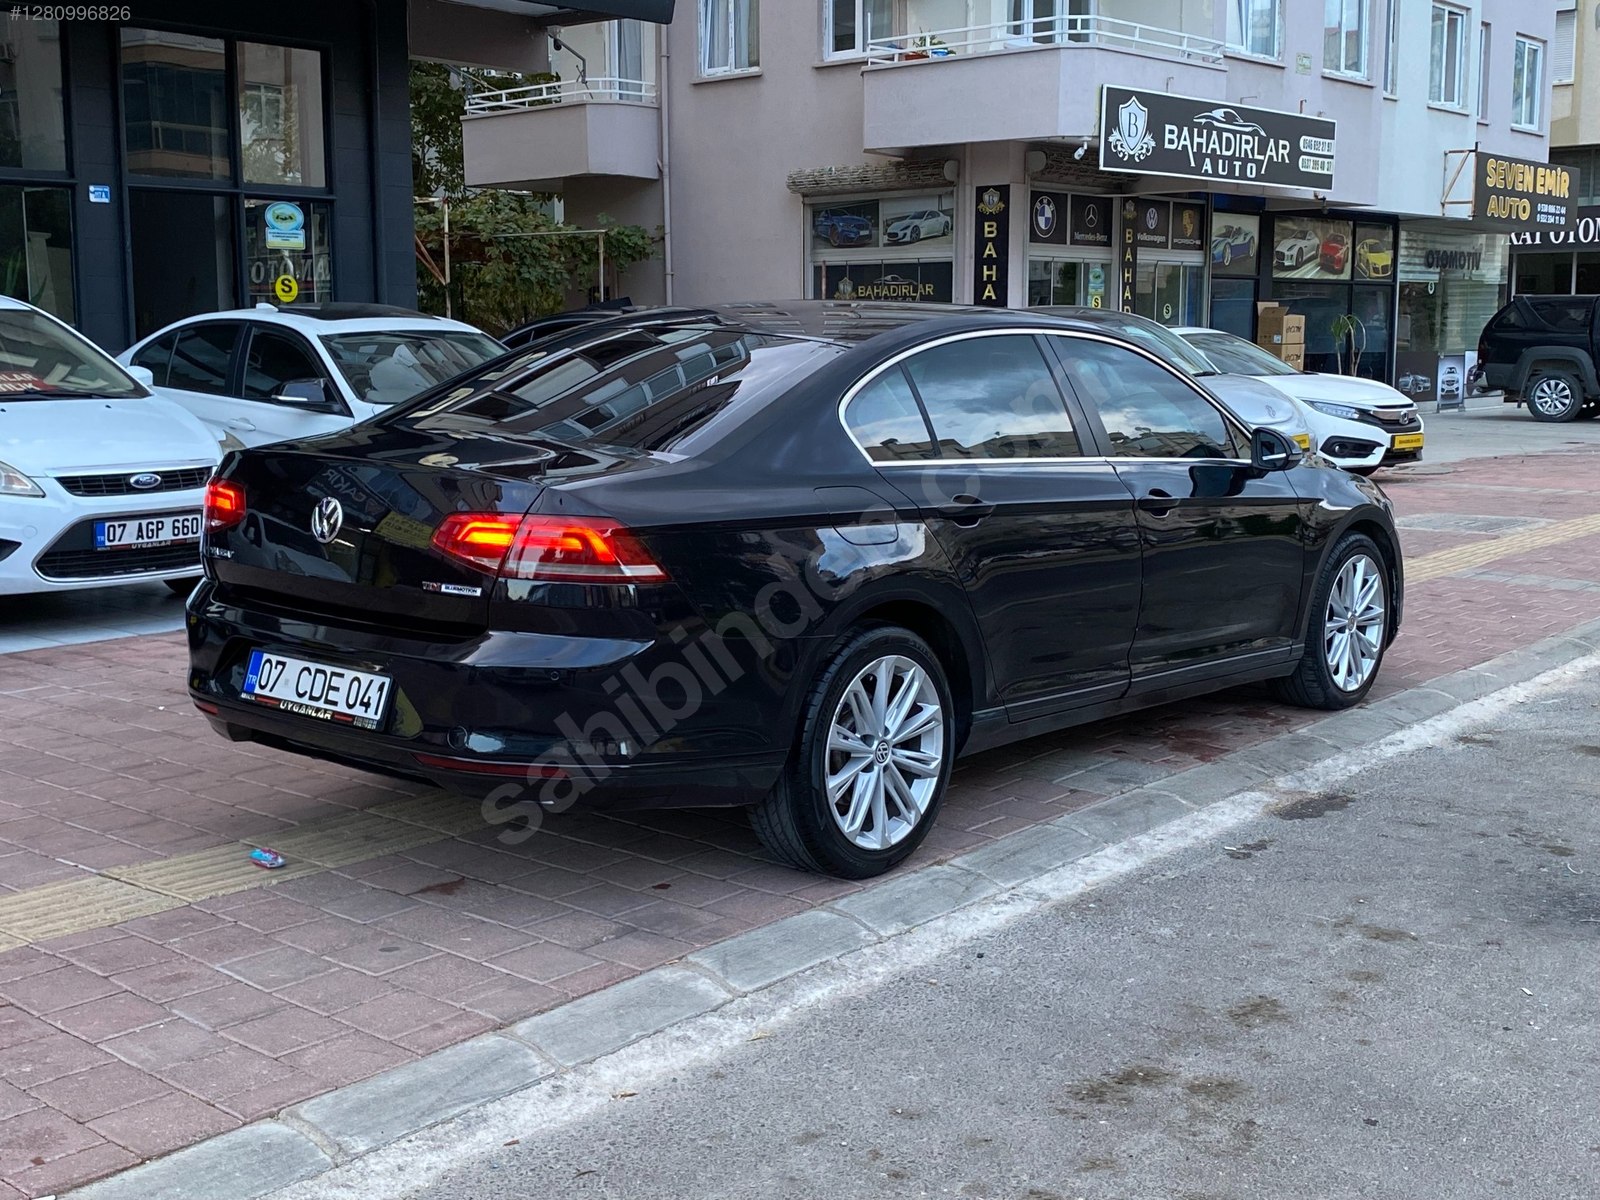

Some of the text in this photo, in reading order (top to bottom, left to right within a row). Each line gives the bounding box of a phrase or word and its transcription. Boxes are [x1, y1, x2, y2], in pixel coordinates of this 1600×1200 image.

[1164, 123, 1290, 174] BAHADIRLAR
[1201, 157, 1257, 179] AUTO
[1486, 158, 1534, 193] SEVEN
[1487, 195, 1531, 221] AUTO
[982, 221, 998, 300] BAHA
[281, 278, 293, 293] S
[857, 283, 934, 300] BAHADIRLAR
[106, 523, 128, 543] 07
[136, 520, 165, 541] AGP
[172, 517, 199, 537] 660
[248, 658, 386, 716] TR 07 CDE 041
[279, 700, 333, 720] UYGANLAR
